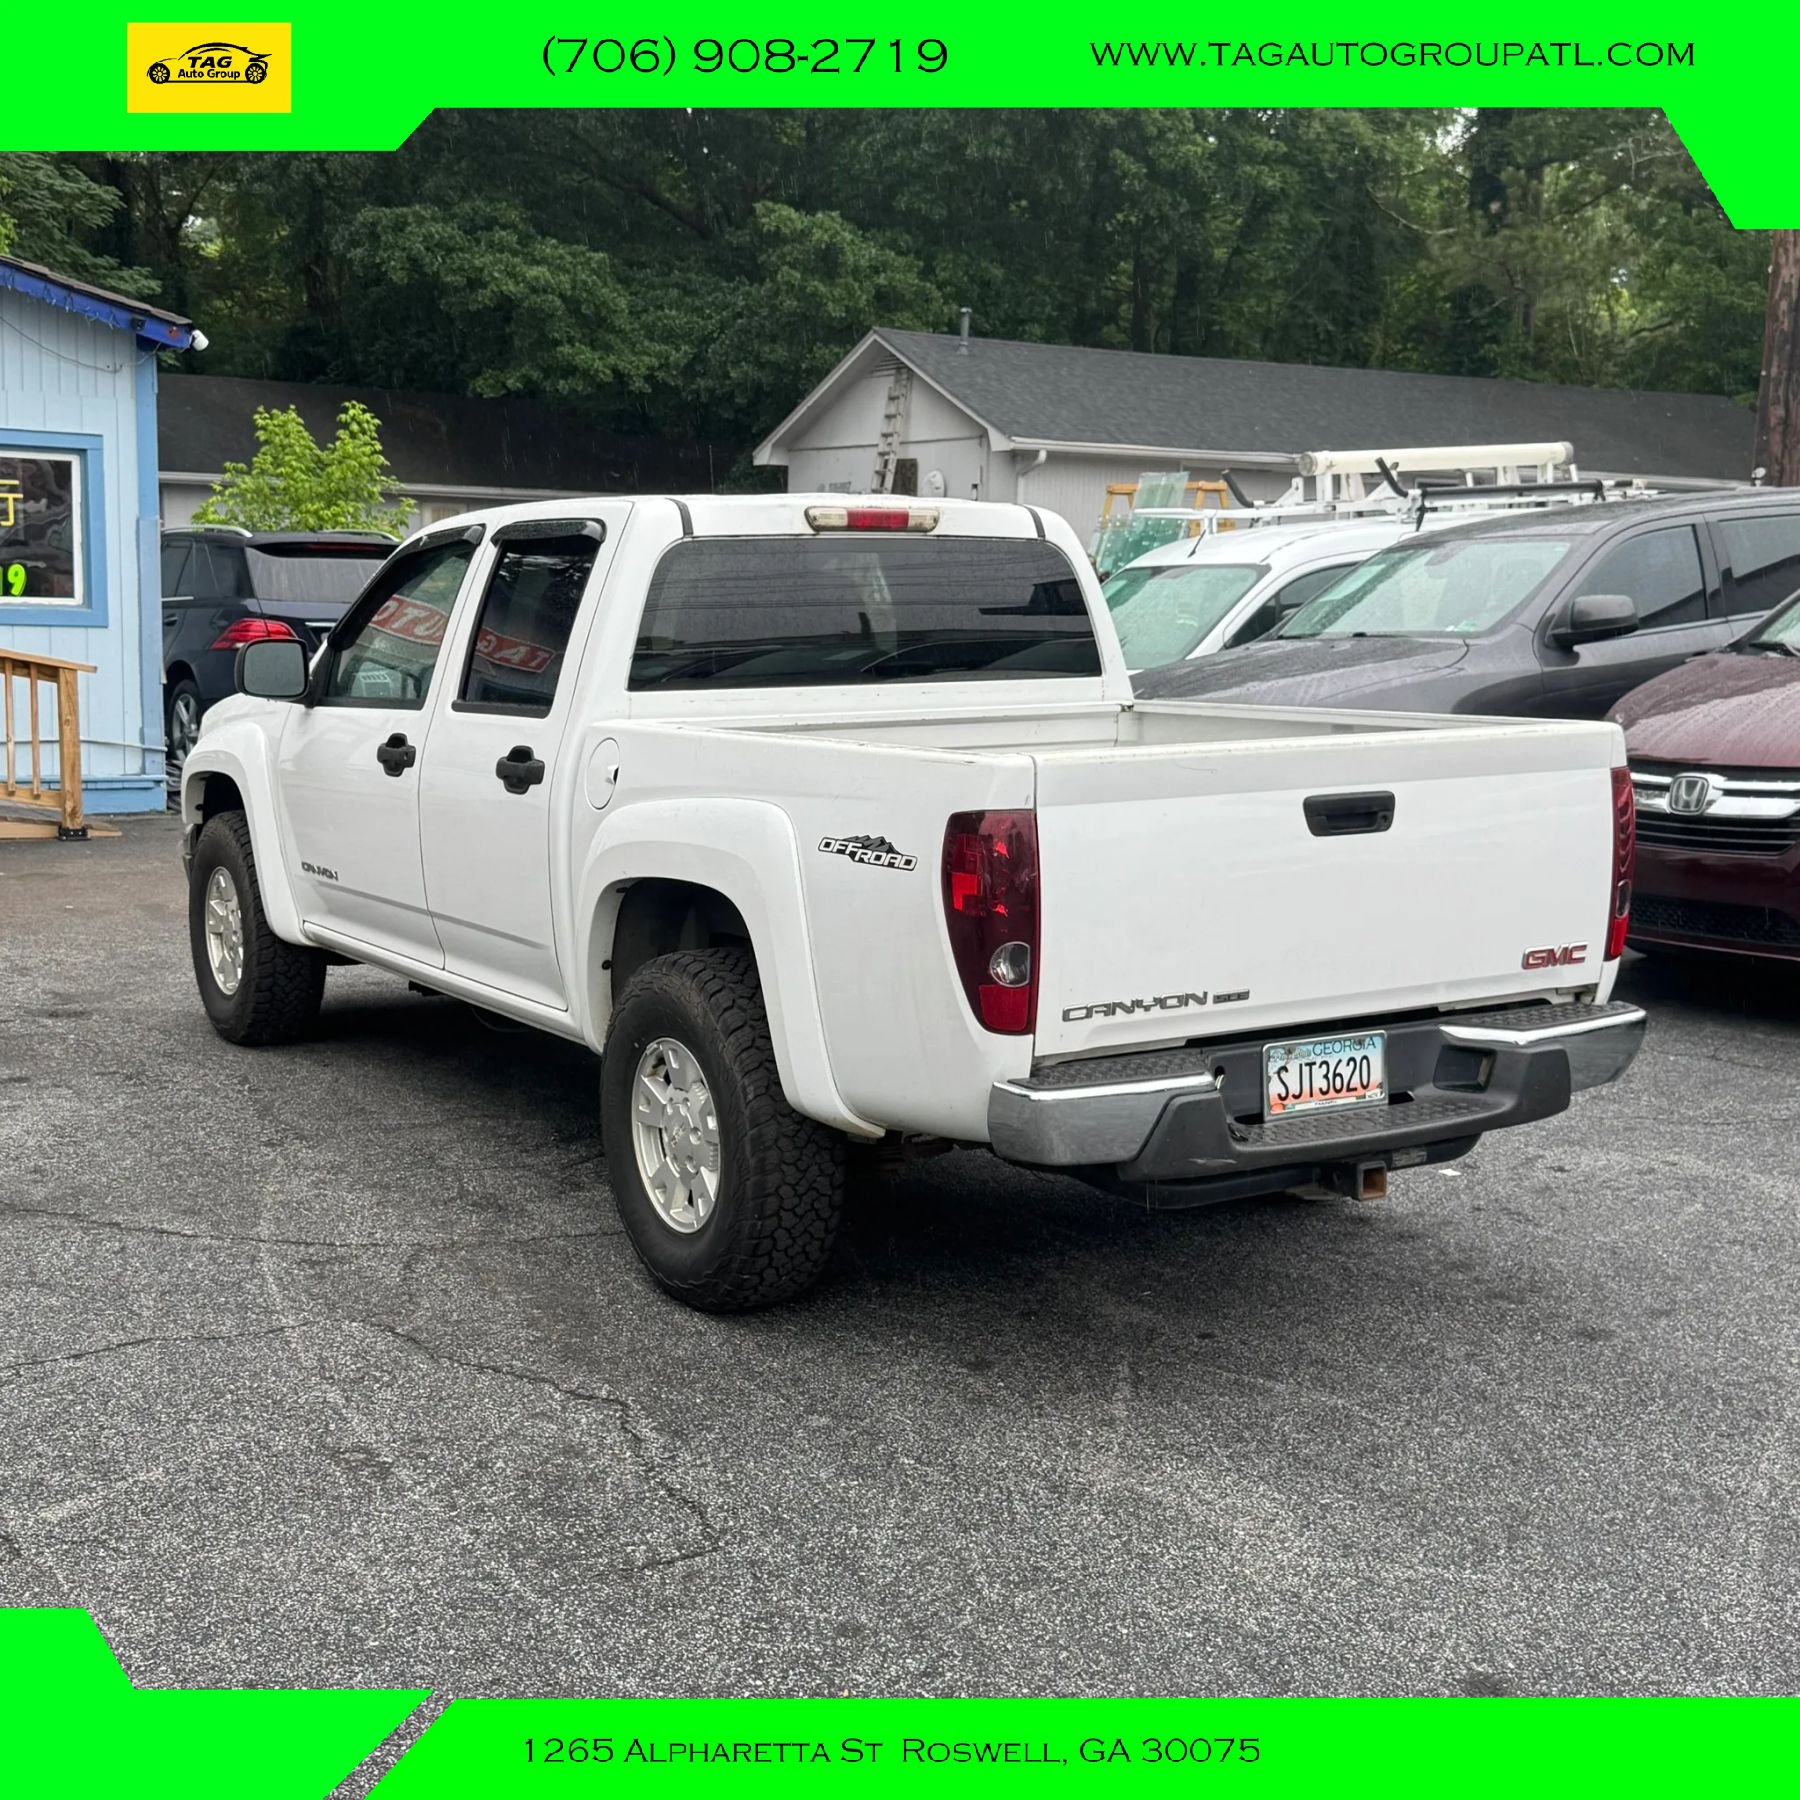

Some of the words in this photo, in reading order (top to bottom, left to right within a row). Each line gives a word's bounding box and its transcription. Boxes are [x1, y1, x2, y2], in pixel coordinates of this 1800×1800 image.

[1522, 941, 1588, 970] GMC
[1062, 991, 1208, 1023] CANYON
[1312, 1037, 1377, 1057] GEORGIA
[1276, 1054, 1371, 1102] SJT3620
